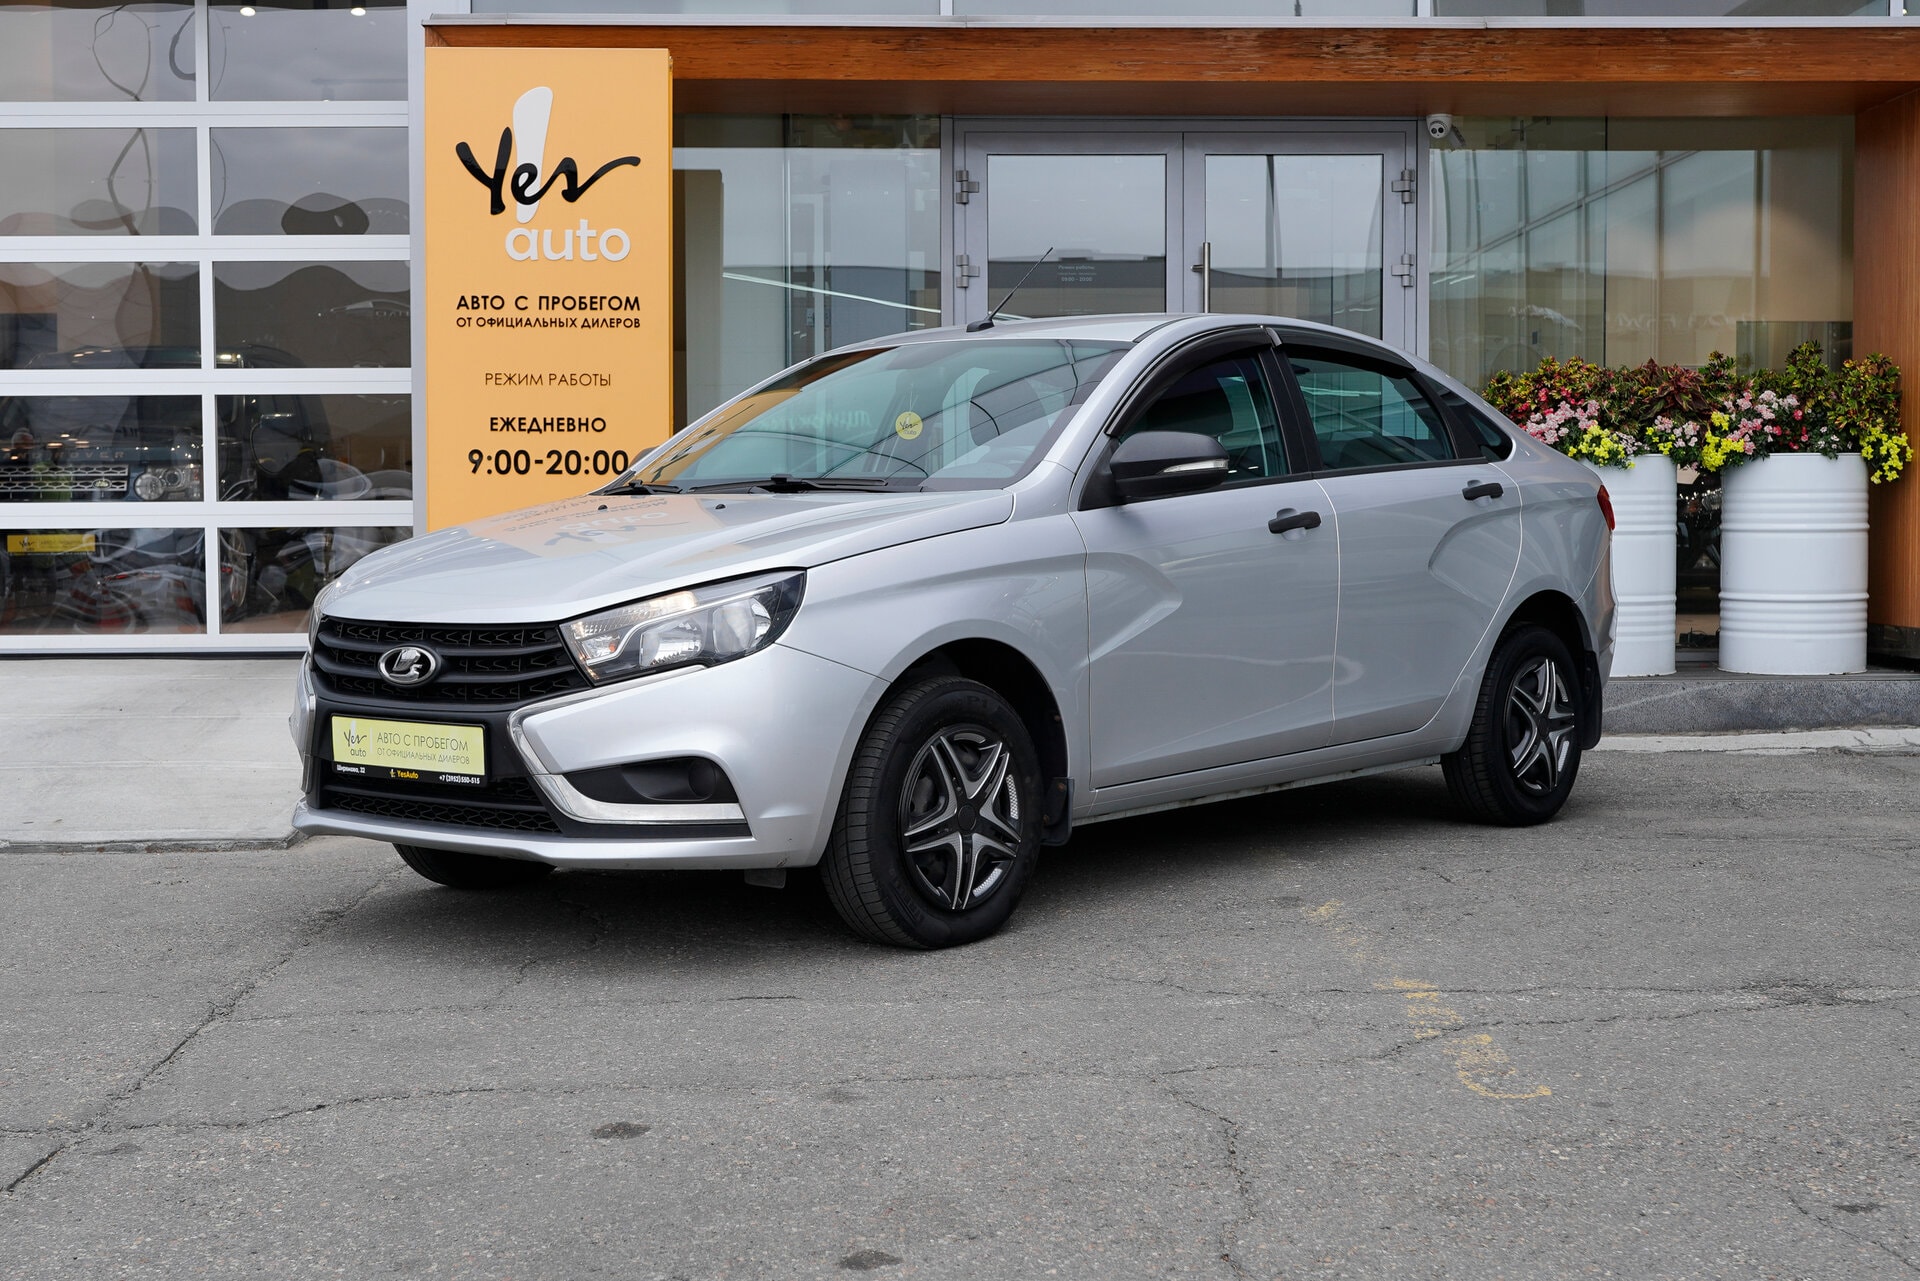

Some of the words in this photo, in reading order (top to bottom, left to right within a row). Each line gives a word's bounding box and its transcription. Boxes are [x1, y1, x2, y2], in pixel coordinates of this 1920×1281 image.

[456, 127, 641, 215] Yes
[505, 219, 631, 261] auto
[456, 295, 505, 311] АВТО
[514, 296, 529, 311] С
[538, 296, 641, 311] ПРОБЕГОМ
[456, 317, 472, 328] ОТ
[476, 317, 577, 329] ОФИЦИАЛЬНЫХ
[581, 318, 641, 329] ДИЛЕРОВ
[485, 373, 543, 386] РЕЖИМ
[549, 373, 611, 386] РАБОТЫ
[489, 417, 607, 434] ЕЖЕДНЕВНО
[468, 449, 629, 475] 9:00-20:00
[344, 729, 367, 747] Yes
[377, 732, 401, 745] АВТО
[403, 734, 411, 746] С
[413, 735, 469, 752] ПРОБЕГОМ
[350, 748, 367, 757] auto
[386, 749, 437, 761] ОФИЦИАЛЬНЫХ
[438, 755, 470, 765] ДИЛЕРОВ
[397, 770, 419, 779] YesAuto
